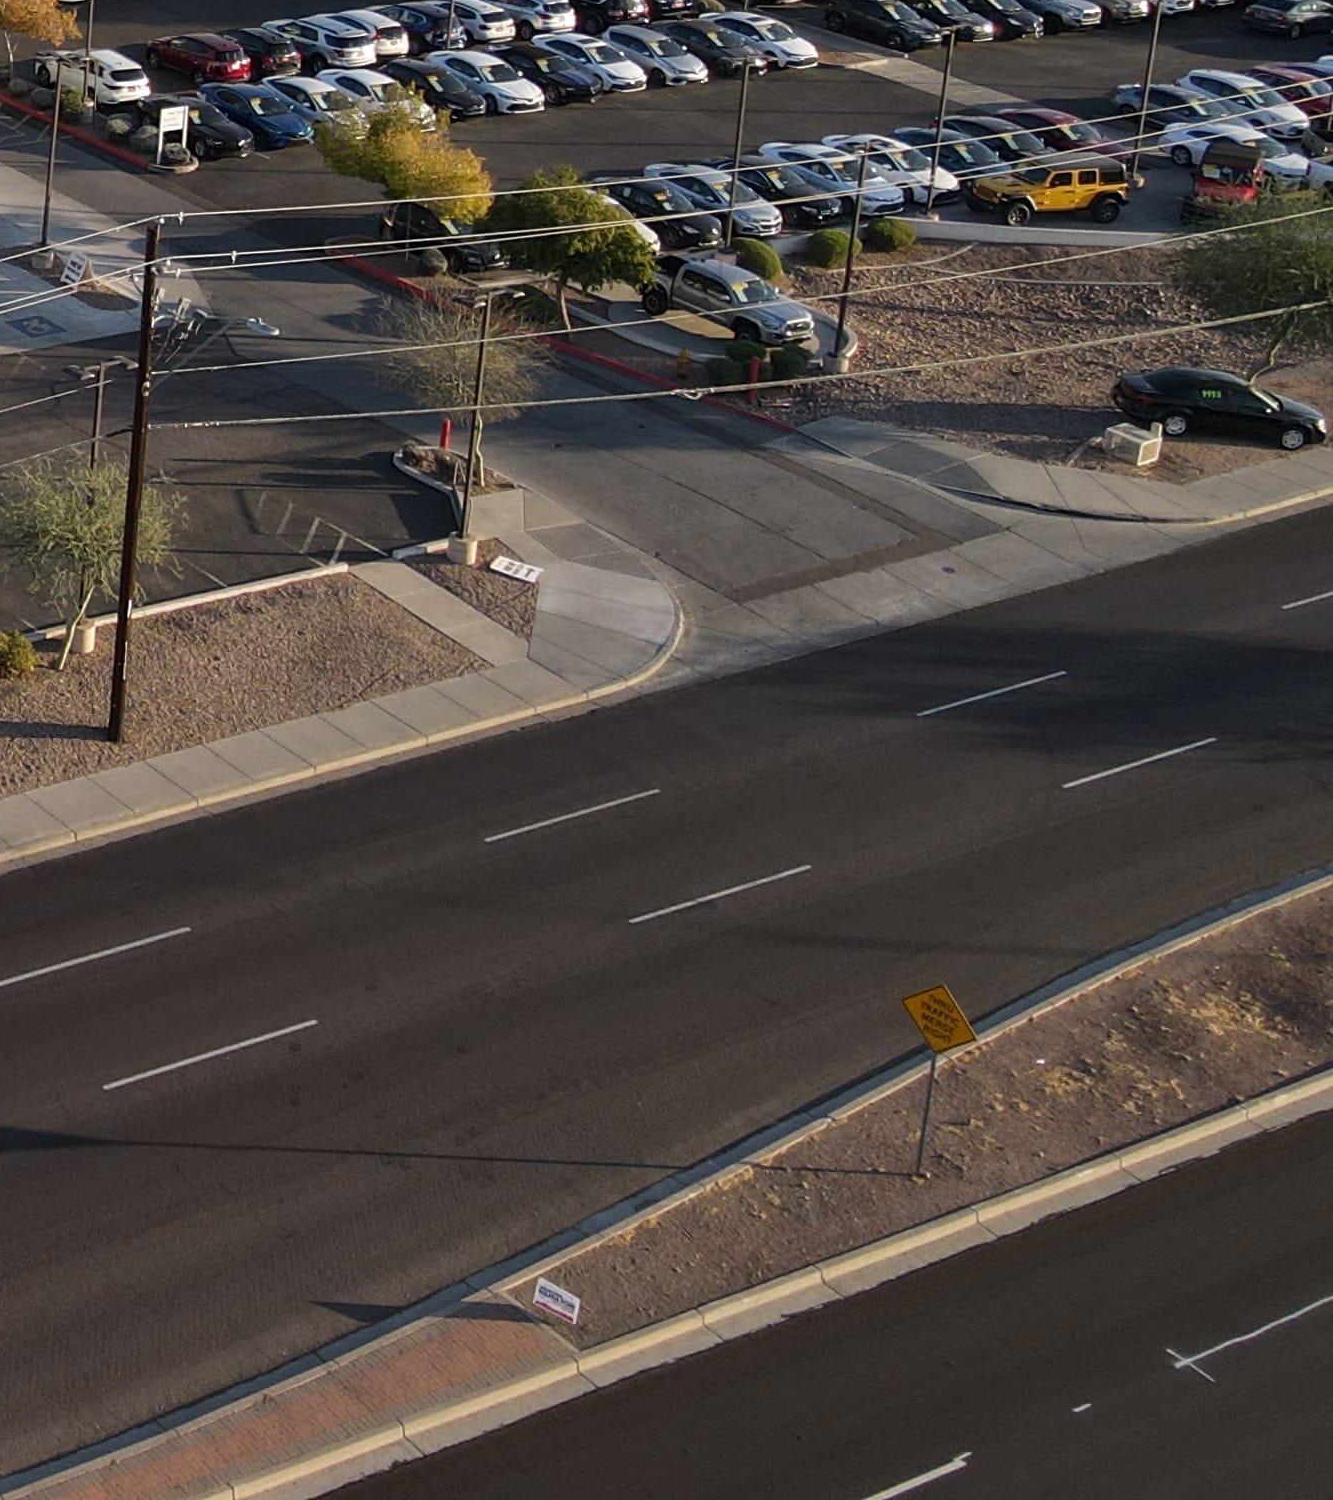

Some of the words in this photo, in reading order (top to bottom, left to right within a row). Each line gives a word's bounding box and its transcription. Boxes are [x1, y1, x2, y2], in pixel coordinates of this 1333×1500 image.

[921, 1001, 960, 1028] TRAFFIC
[929, 994, 954, 1013] THRU
[921, 1012, 955, 1036] MERGE
[923, 1024, 951, 1044] RIGHT
